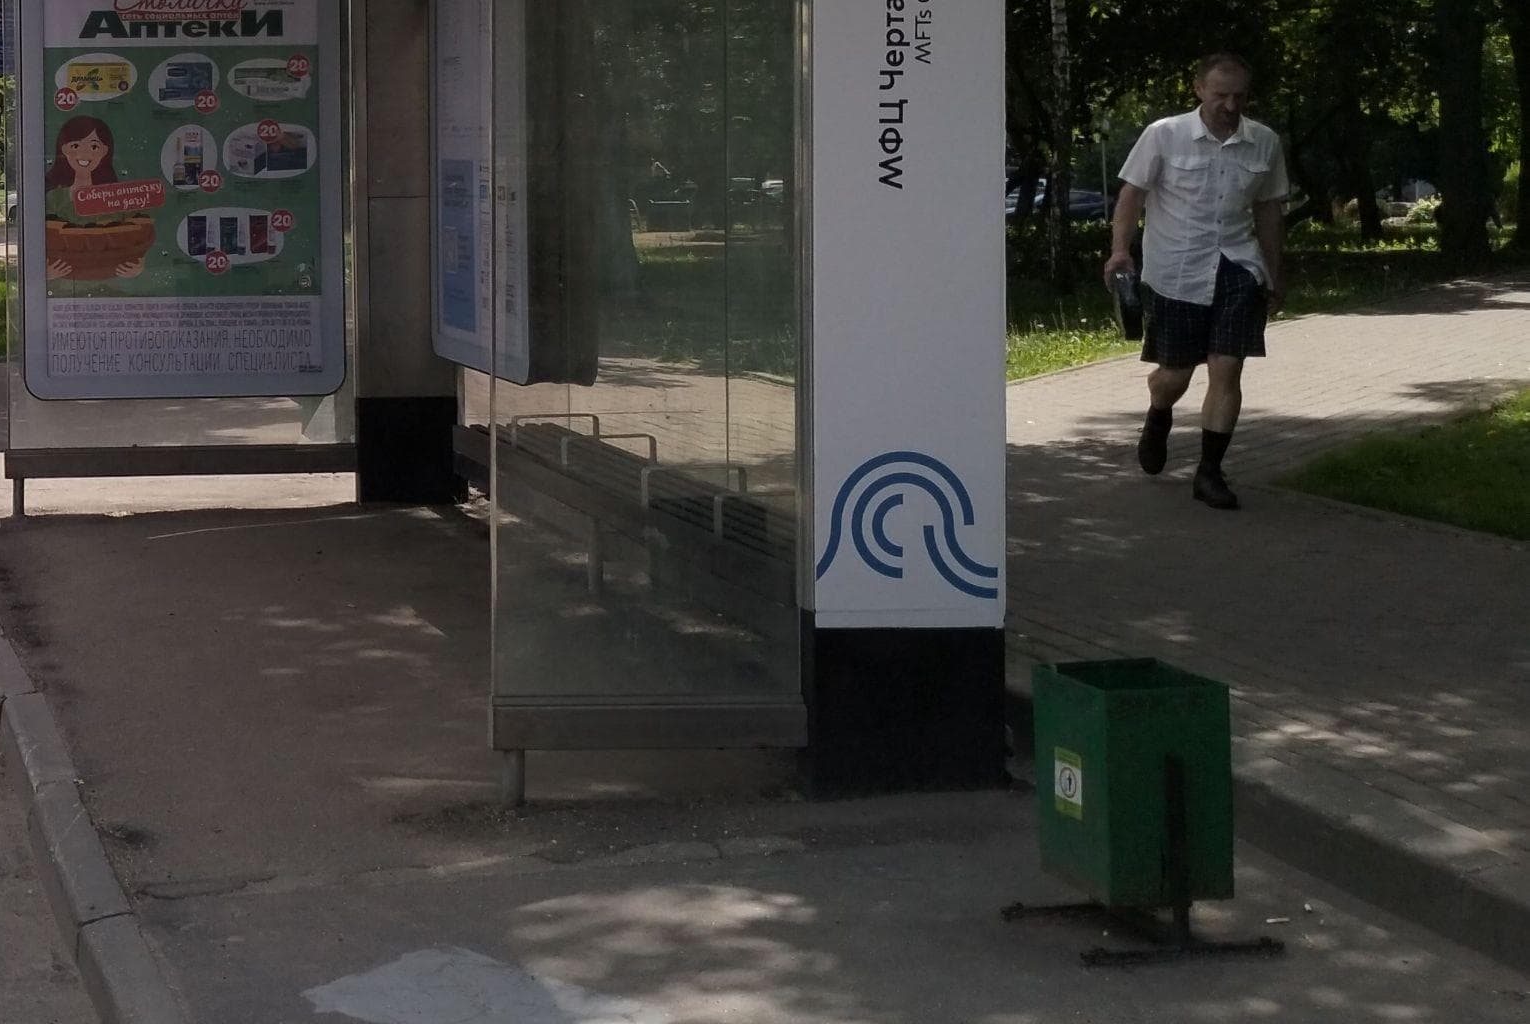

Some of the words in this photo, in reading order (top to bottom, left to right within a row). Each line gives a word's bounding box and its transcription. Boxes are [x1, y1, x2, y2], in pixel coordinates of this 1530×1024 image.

[914, 9, 933, 65] MFTs
[290, 59, 307, 71] 20
[57, 92, 76, 105] 20
[197, 95, 215, 108] 20
[260, 125, 278, 136] 20
[878, 99, 908, 189] МФЦ
[201, 175, 219, 186] 20
[77, 188, 115, 203] Собери
[107, 197, 119, 208] на
[119, 193, 150, 209] дачу!
[273, 214, 292, 226] 20
[207, 256, 226, 269] 20
[52, 331, 107, 351] ИМЕЮТСЯ
[233, 329, 312, 349] НЕОБХОДИМО
[52, 353, 121, 373] ПОЛУЧЕНИЕ
[128, 352, 221, 373] КОНСУЛЬТАЦИИ
